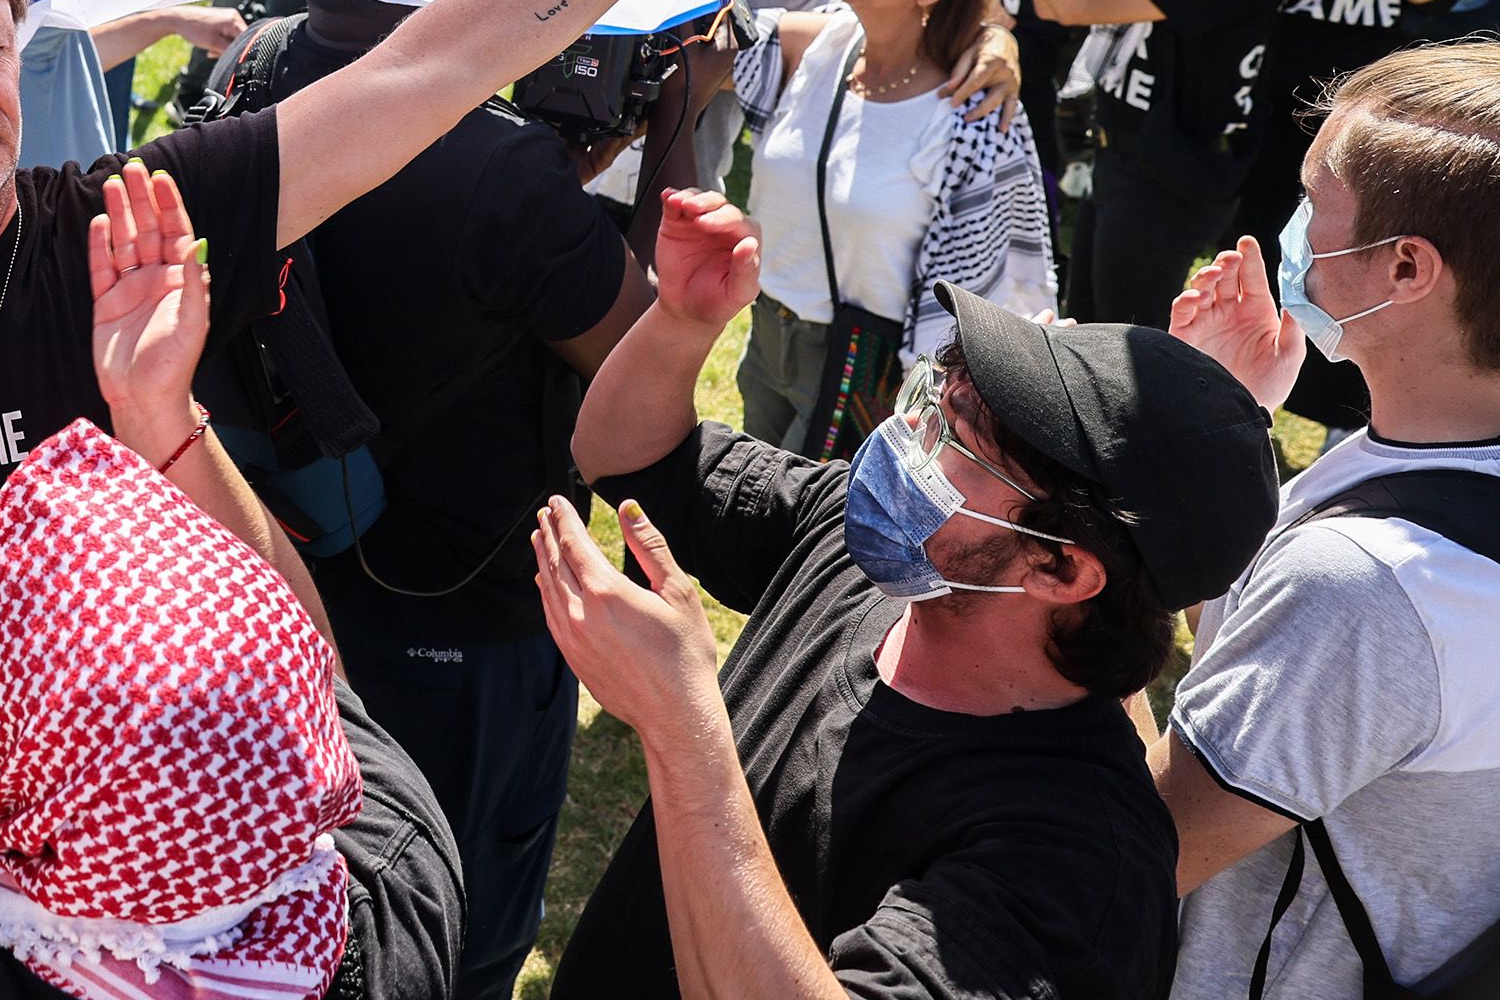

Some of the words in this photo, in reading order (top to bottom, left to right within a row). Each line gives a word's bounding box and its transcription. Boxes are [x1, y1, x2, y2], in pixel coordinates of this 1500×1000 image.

[534, 0, 569, 21] Love
[574, 64, 598, 77] 150
[418, 647, 463, 657] Columbia
